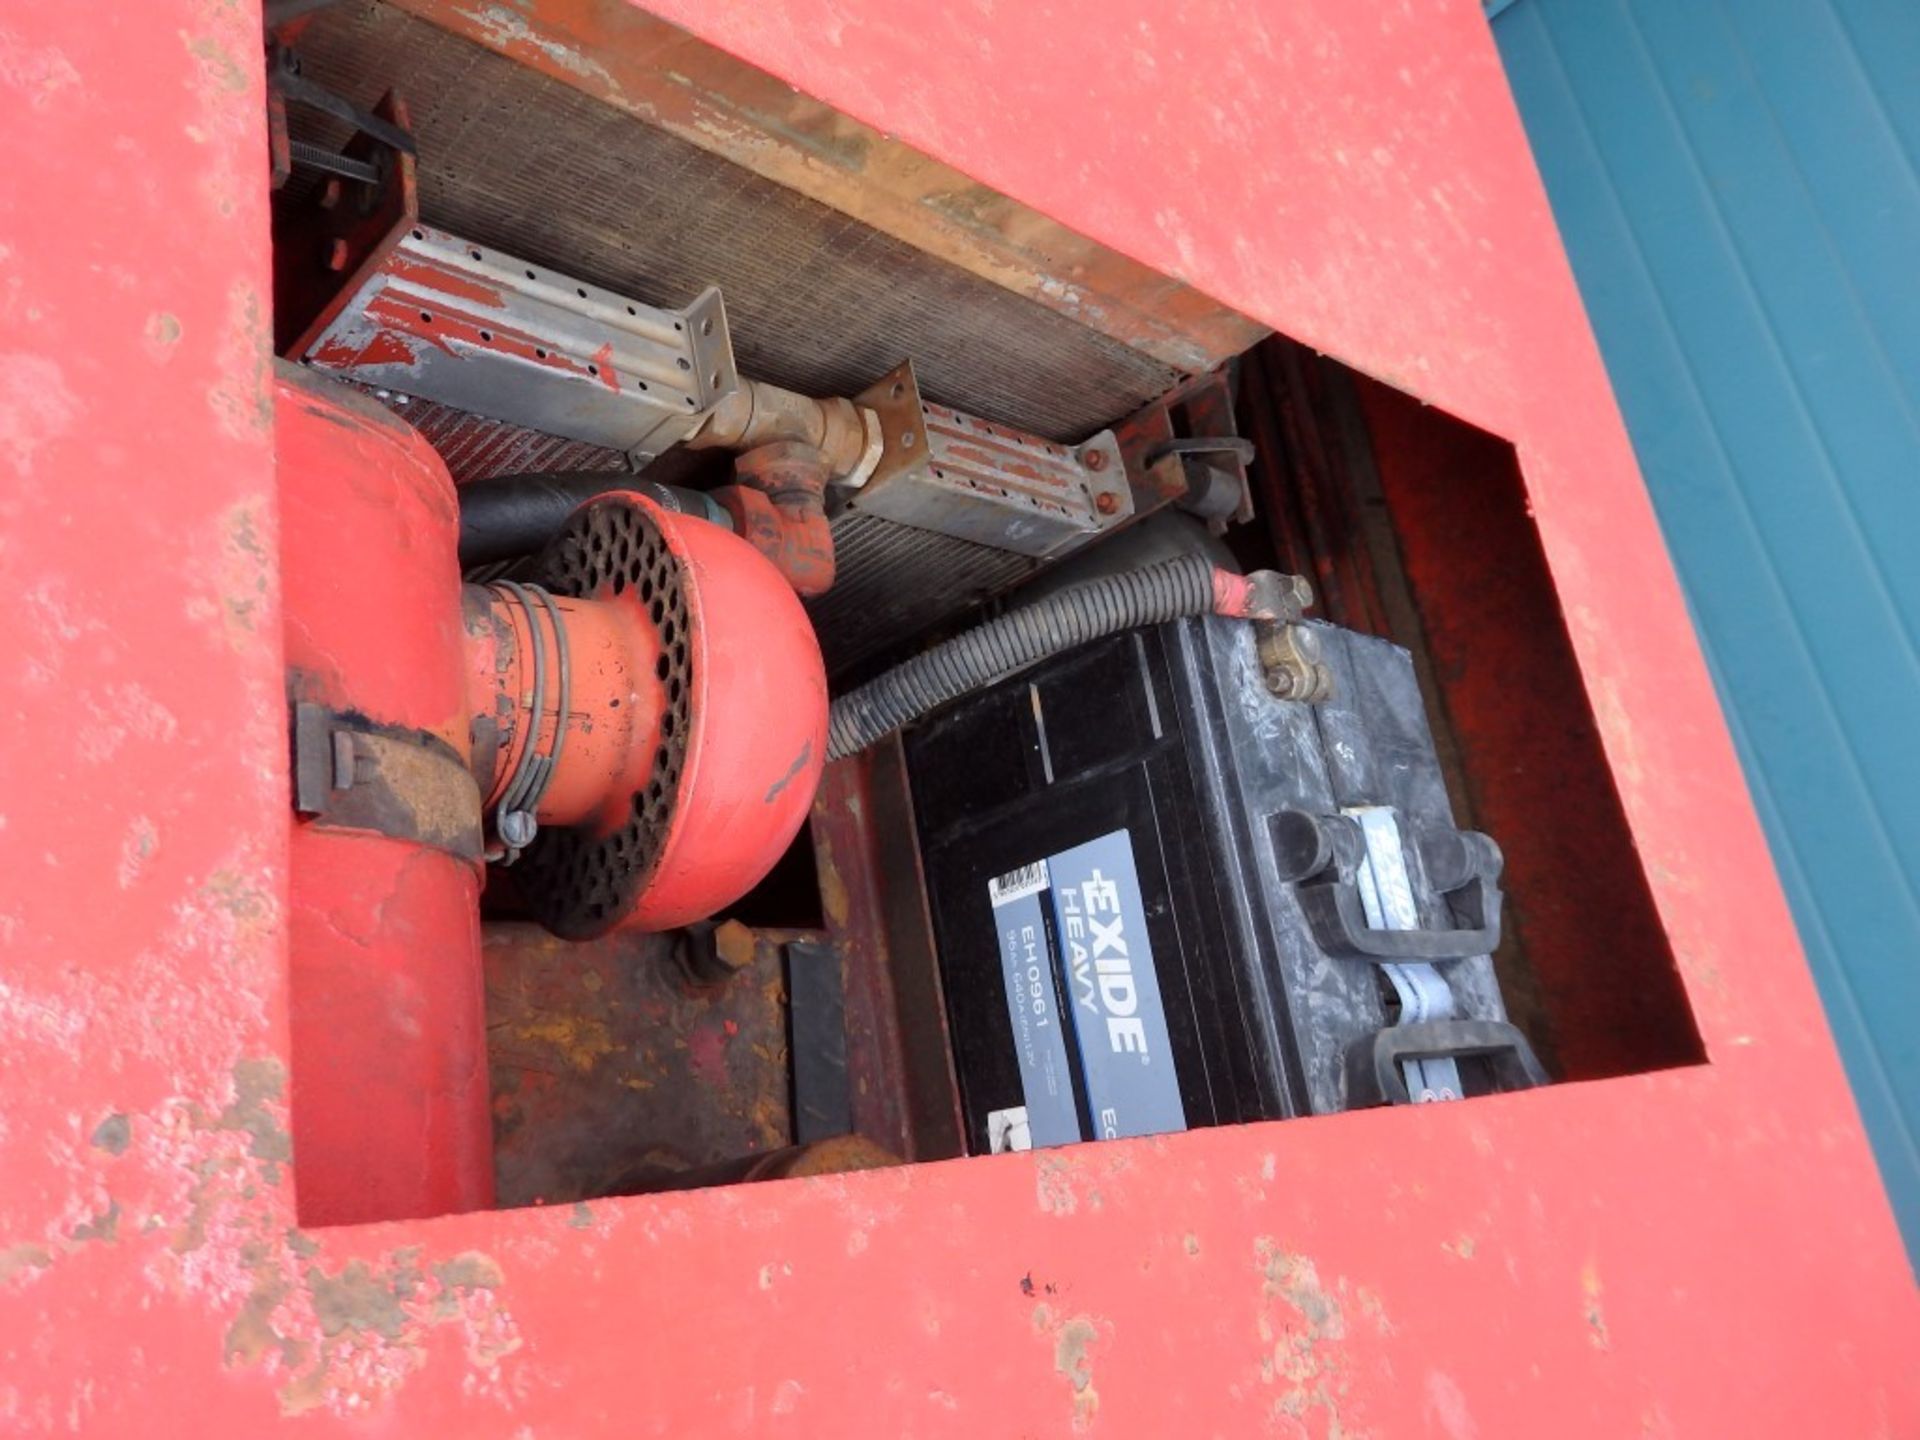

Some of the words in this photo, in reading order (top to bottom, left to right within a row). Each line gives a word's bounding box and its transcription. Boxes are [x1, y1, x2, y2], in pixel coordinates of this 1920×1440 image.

[1021, 925, 1049, 1028] EH0961
[1061, 887, 1099, 1015] HEAVY
[1082, 869, 1148, 1053] EXIDE
